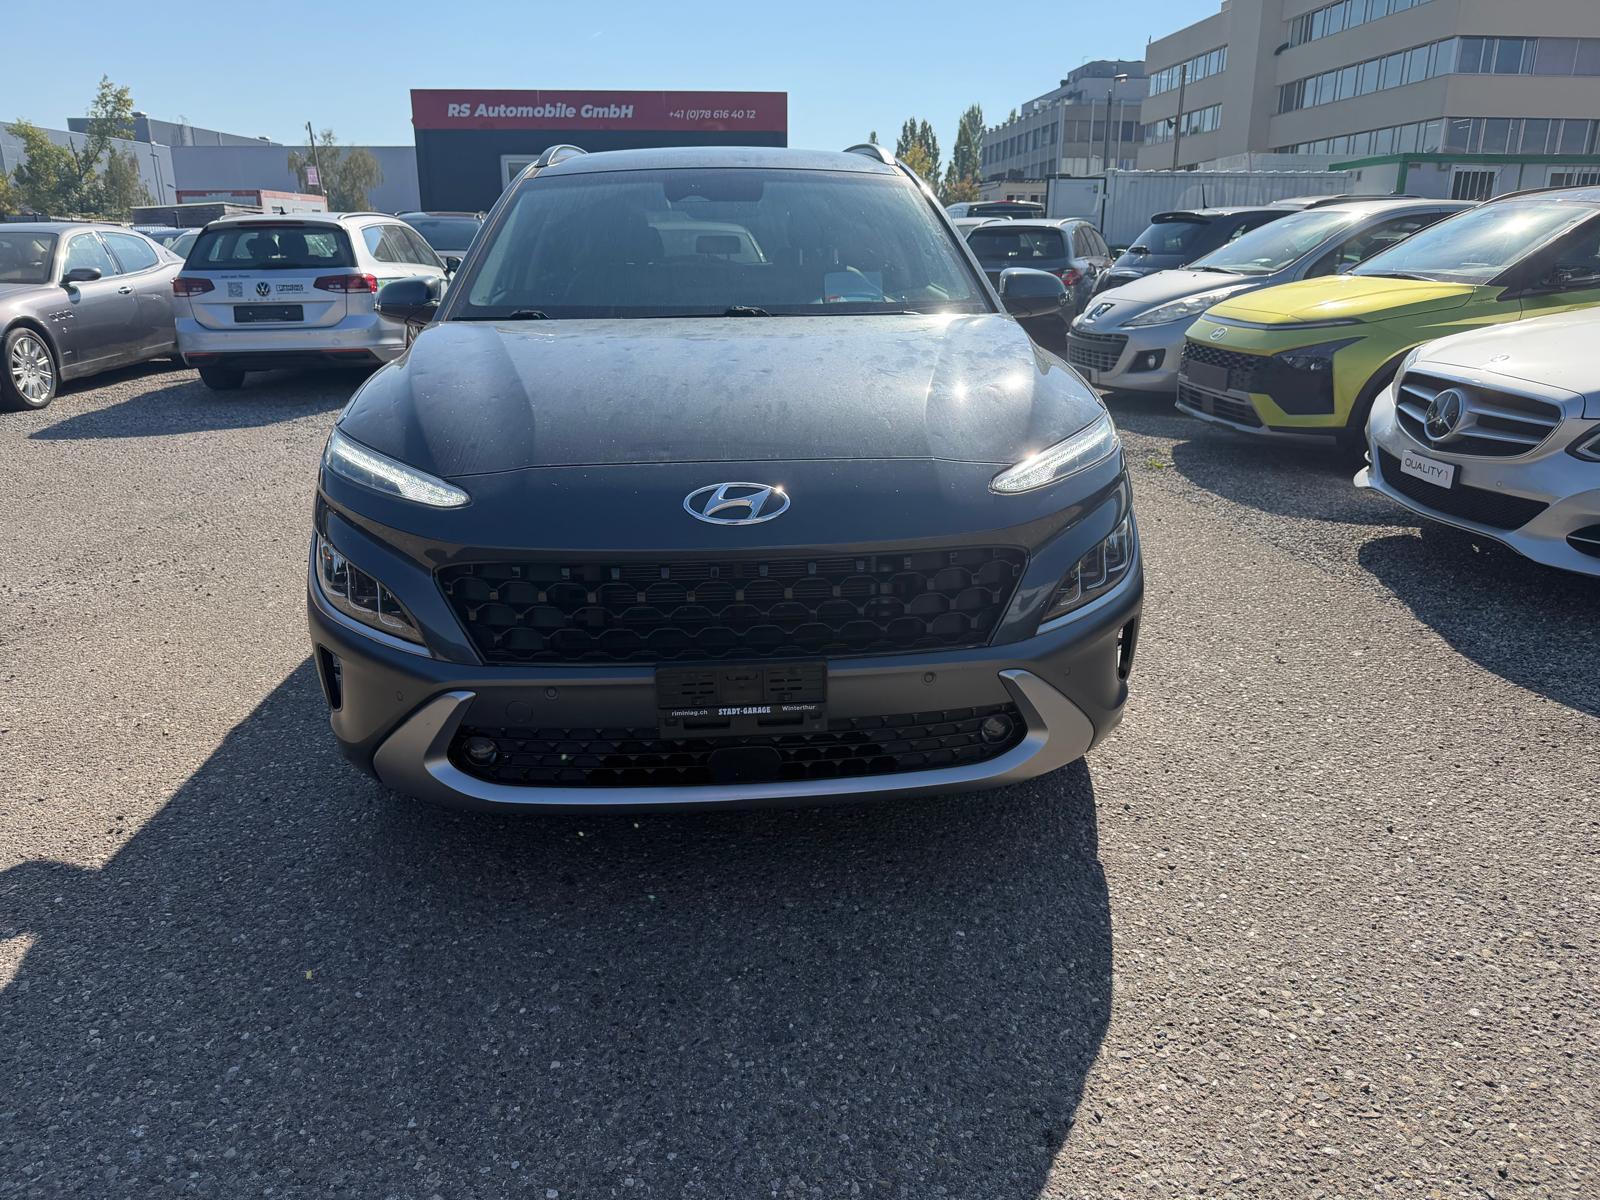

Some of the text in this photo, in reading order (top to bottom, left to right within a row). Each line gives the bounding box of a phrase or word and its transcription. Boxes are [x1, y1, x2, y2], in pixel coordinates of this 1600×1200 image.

[447, 102, 634, 119] RS Automobile GmbH
[669, 110, 685, 119] +41
[713, 110, 729, 119] 616
[731, 110, 744, 119] 40
[746, 110, 756, 119] 12
[1405, 458, 1443, 478] QUALITY
[718, 706, 771, 716] STADT-GARAGE
[781, 704, 817, 712] Winterthur
